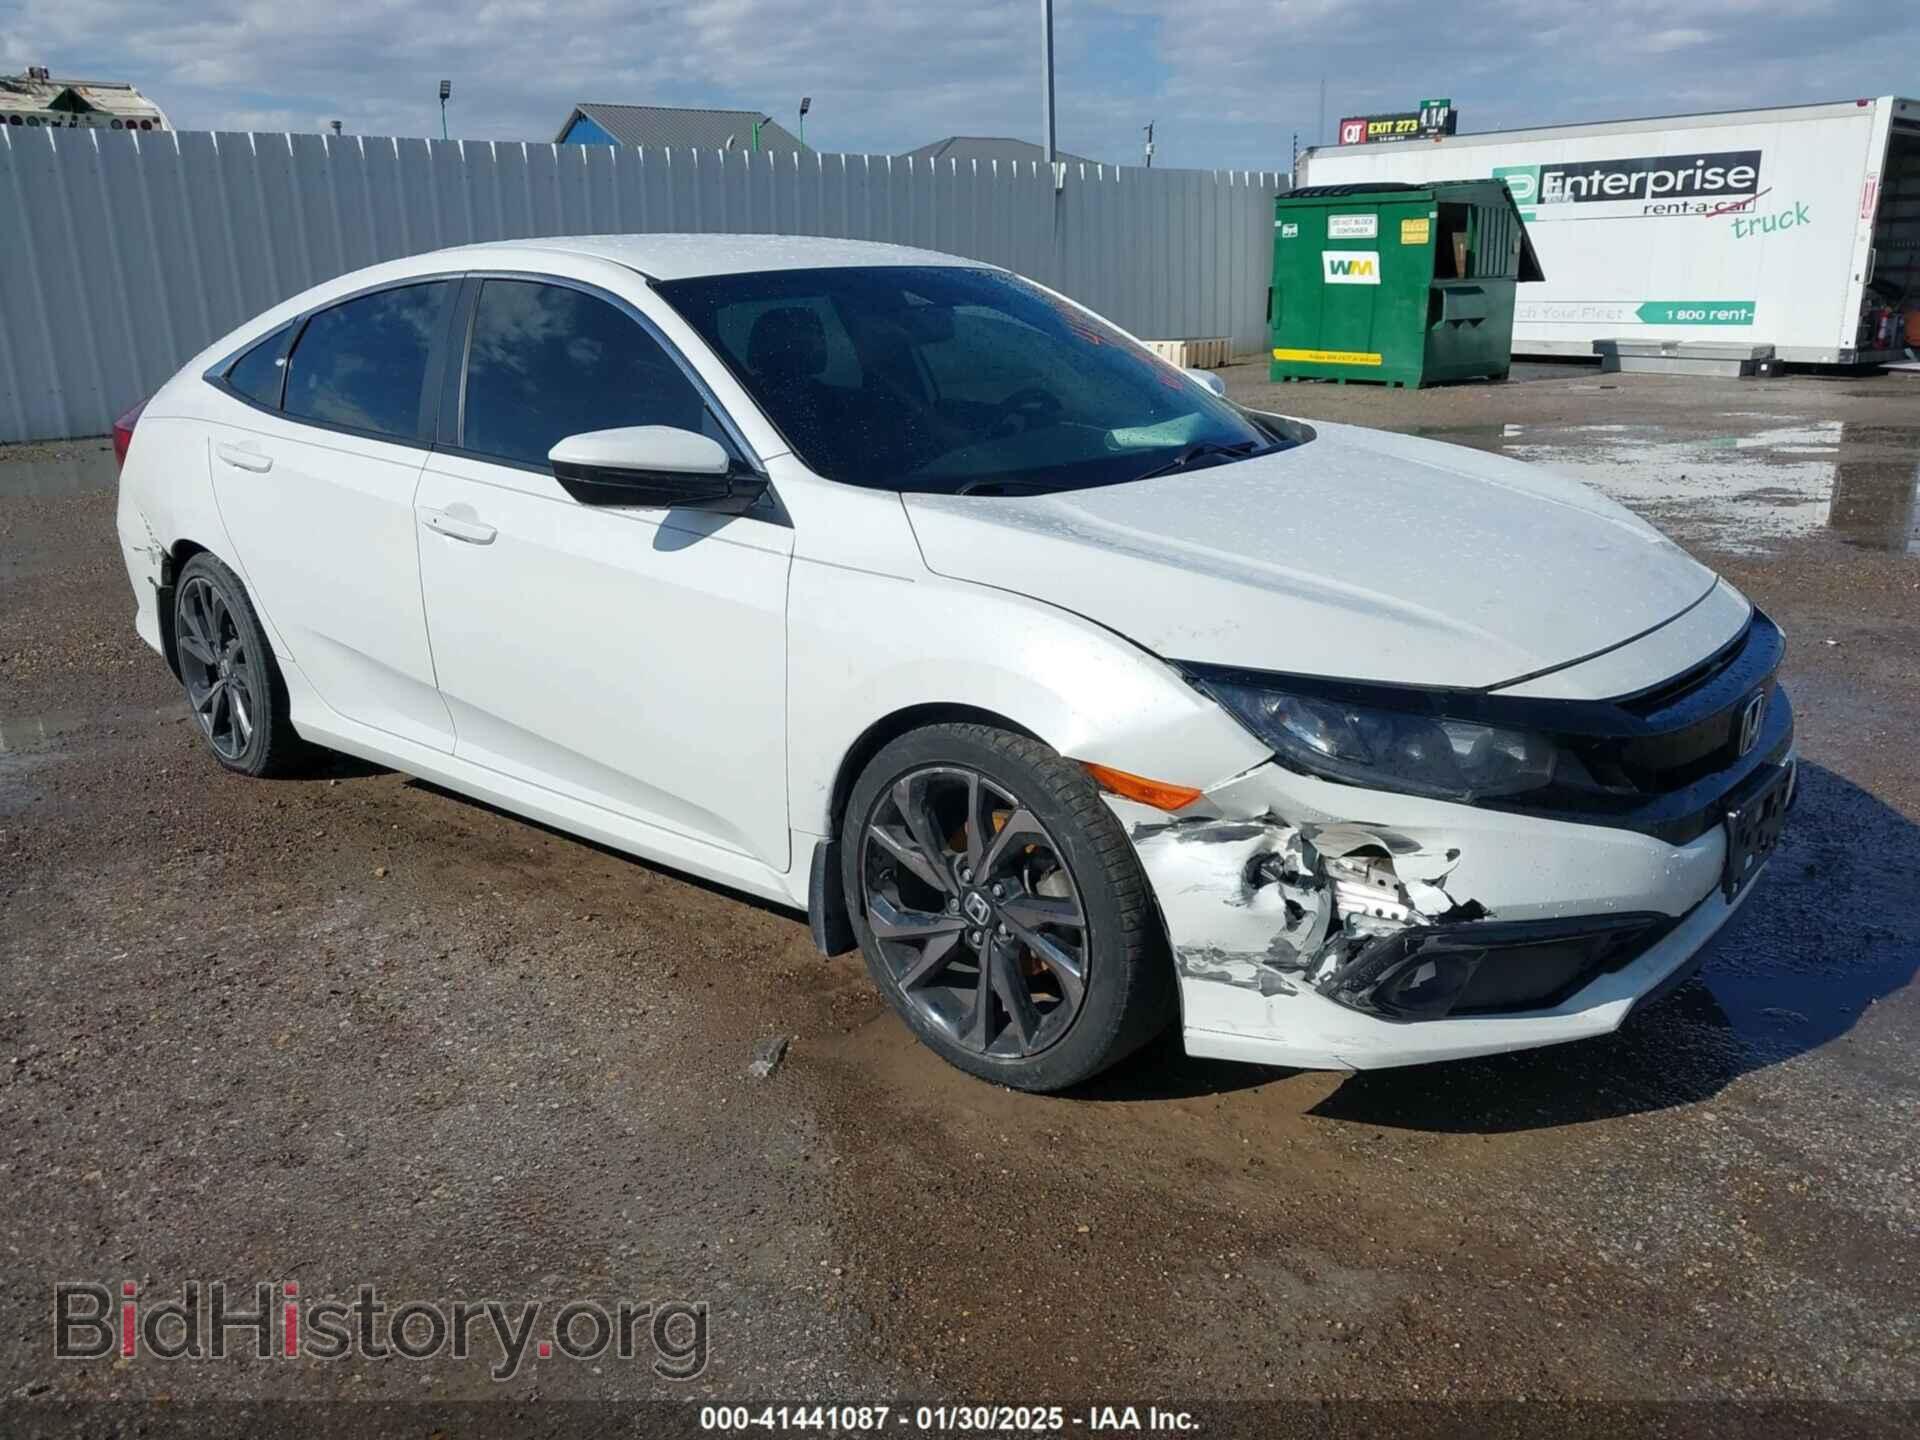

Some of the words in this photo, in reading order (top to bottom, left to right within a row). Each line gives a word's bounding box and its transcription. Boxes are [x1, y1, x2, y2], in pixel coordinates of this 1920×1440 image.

[1344, 125, 1363, 144] QT
[1368, 121, 1394, 134] EXIT
[1395, 119, 1418, 133] 273
[1541, 160, 1756, 199] Enterprise
[1643, 200, 1749, 215] rent-a-car
[1731, 201, 1811, 239] truck
[1330, 259, 1373, 275] WM
[1665, 309, 1673, 320] 1
[1676, 309, 1705, 320] 800
[1709, 307, 1753, 320] rent-
